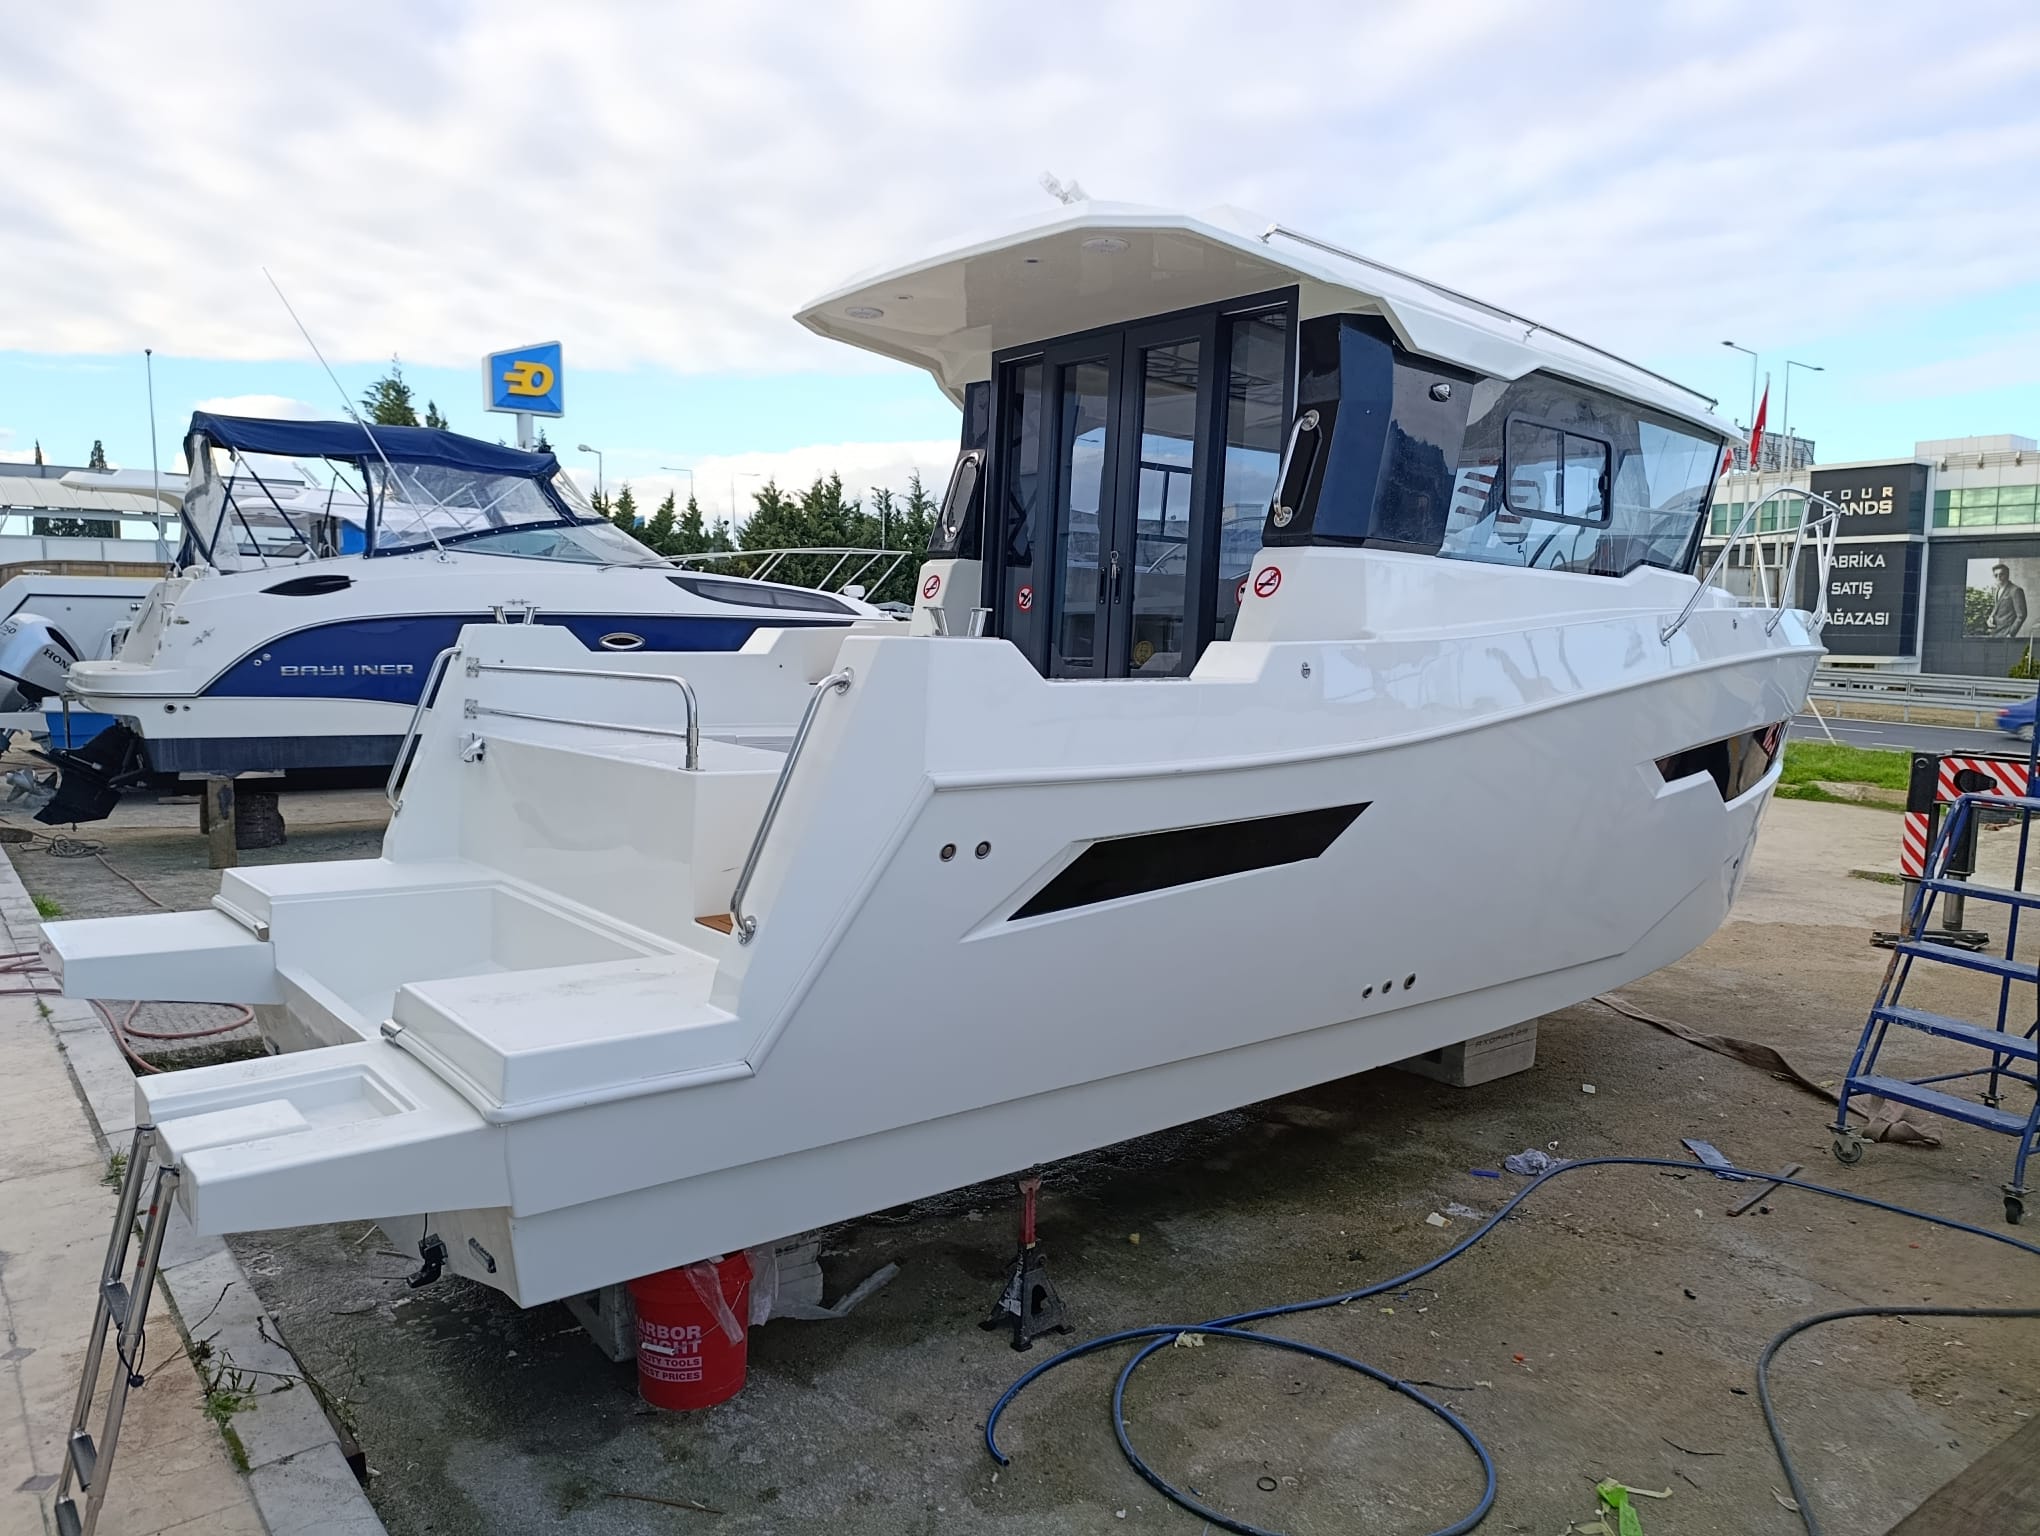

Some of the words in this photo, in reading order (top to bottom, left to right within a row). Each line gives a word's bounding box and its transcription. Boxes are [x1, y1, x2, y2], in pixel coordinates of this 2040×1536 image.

[1823, 486, 1893, 500] FOUR
[1825, 551, 1886, 568] ABRİKA
[1831, 581, 1873, 599] SATIŞ
[1825, 608, 1889, 625] AĞAZASI
[43, 648, 71, 672] HON
[664, 1358, 700, 1367] TOOLS
[663, 1371, 701, 1381] PRICES
